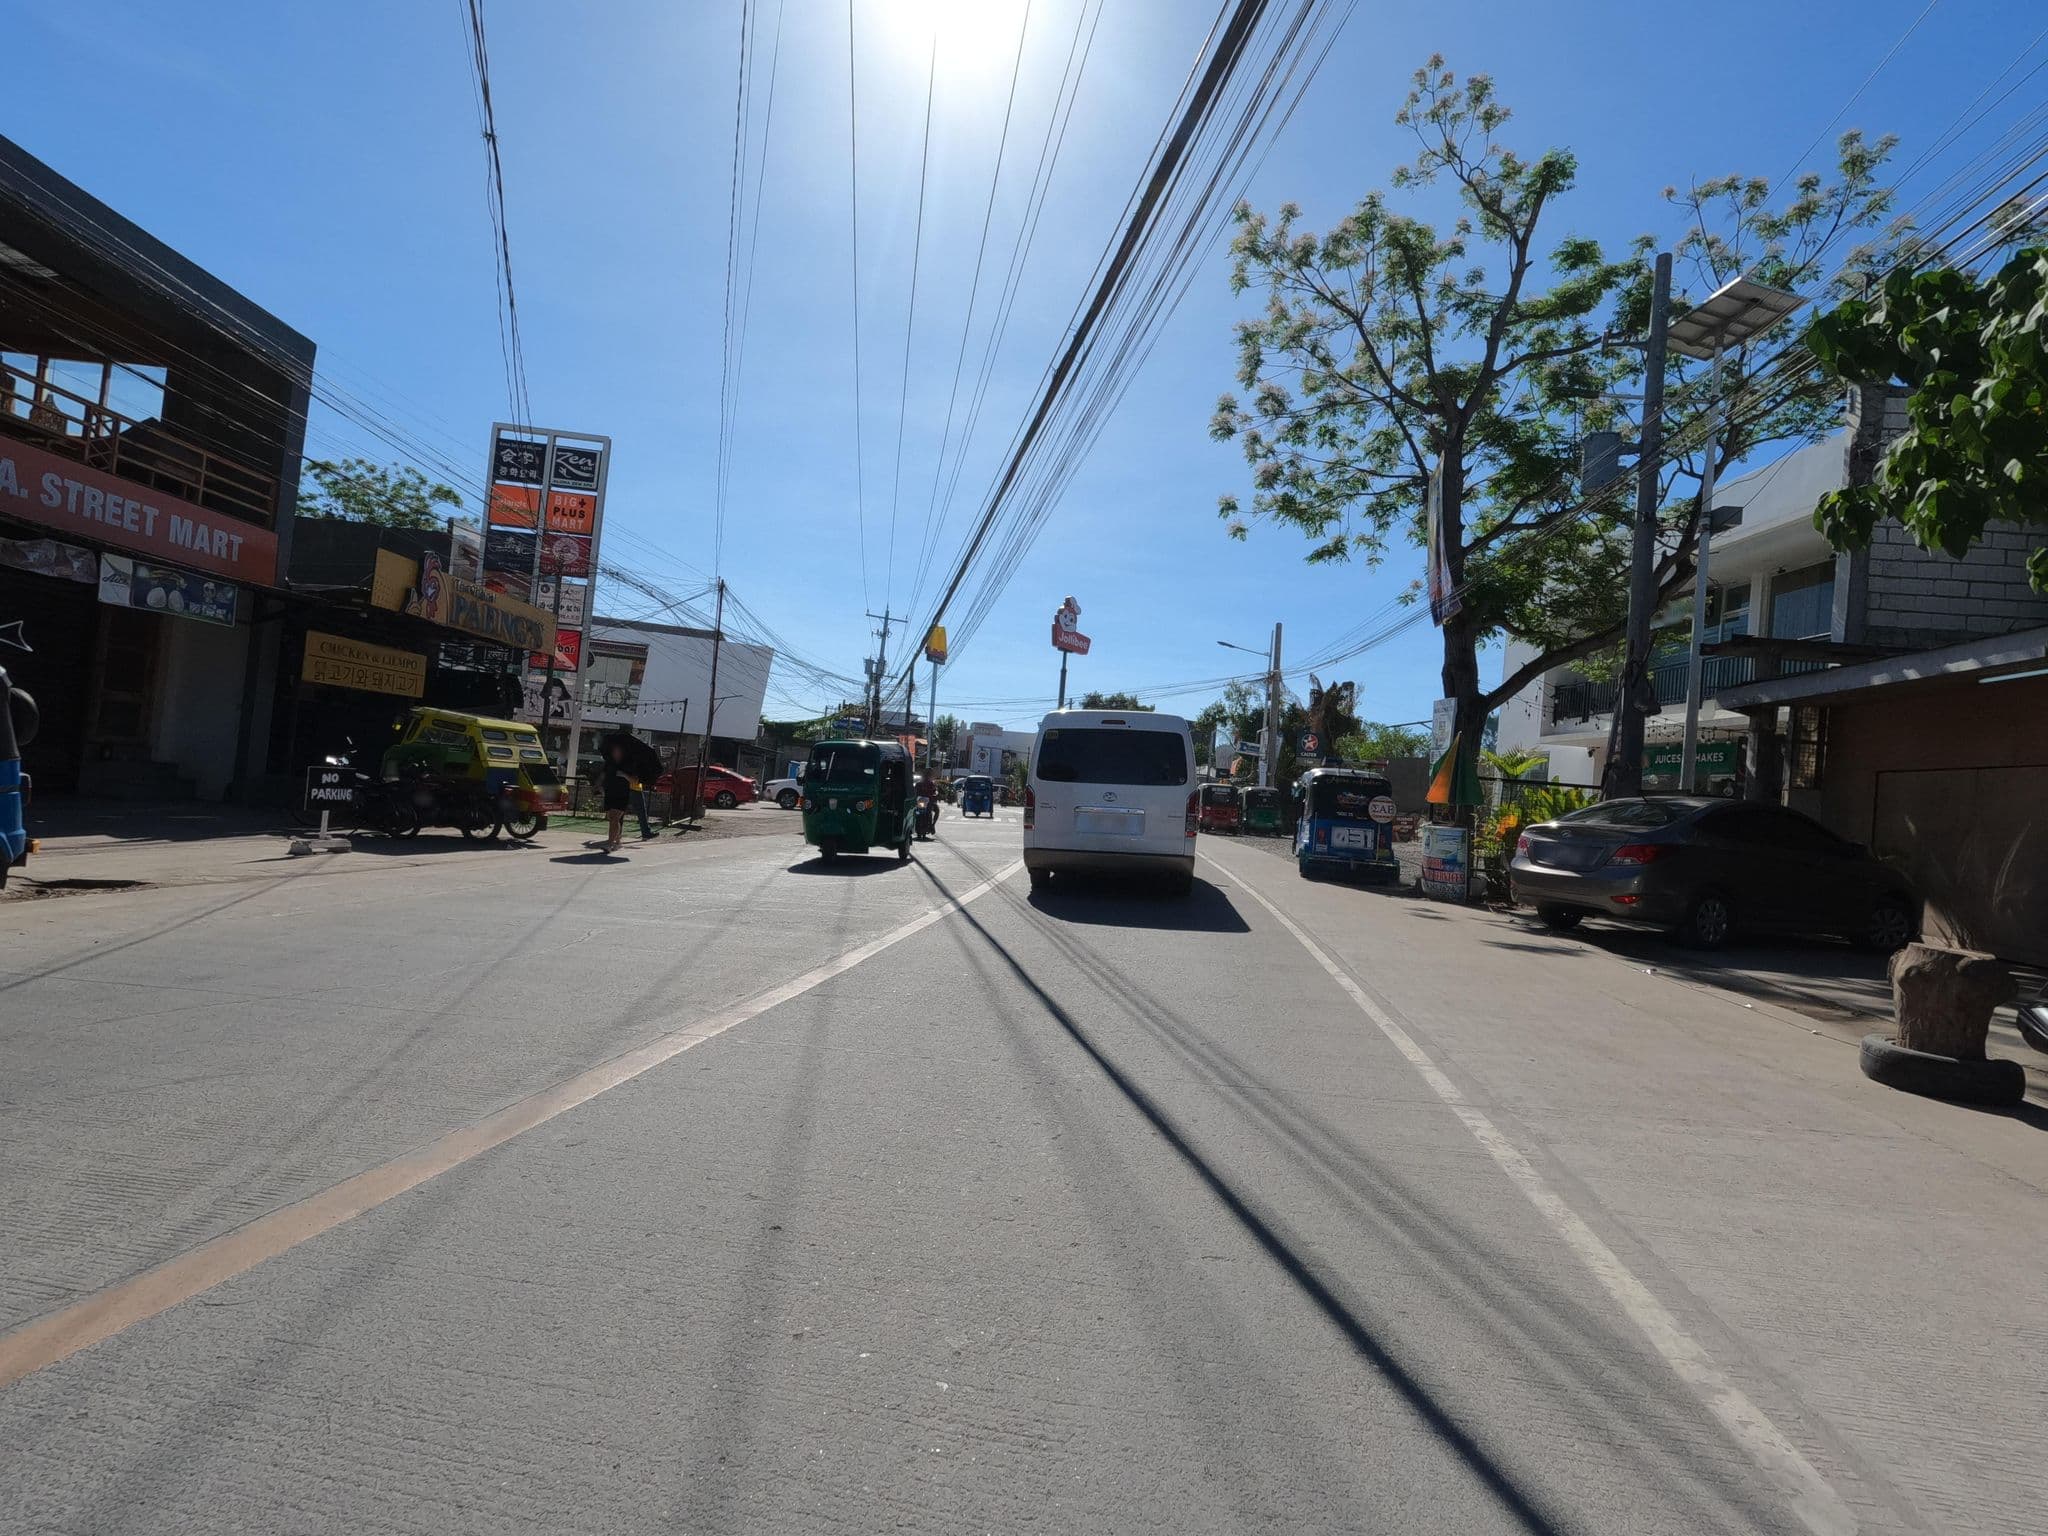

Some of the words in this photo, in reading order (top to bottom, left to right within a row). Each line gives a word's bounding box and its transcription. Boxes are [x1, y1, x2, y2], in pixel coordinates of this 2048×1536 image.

[556, 451, 594, 471] Zen
[40, 472, 160, 537] STREET
[169, 515, 243, 562] MART
[553, 507, 585, 519] PLUS
[551, 517, 584, 530] MART
[1059, 633, 1089, 649] Jollibee
[320, 640, 369, 661] CHICKEN
[1654, 753, 1681, 764] JUICES
[1696, 752, 1724, 763] HAKES
[322, 772, 339, 783] NO
[311, 788, 352, 800] PARKING
